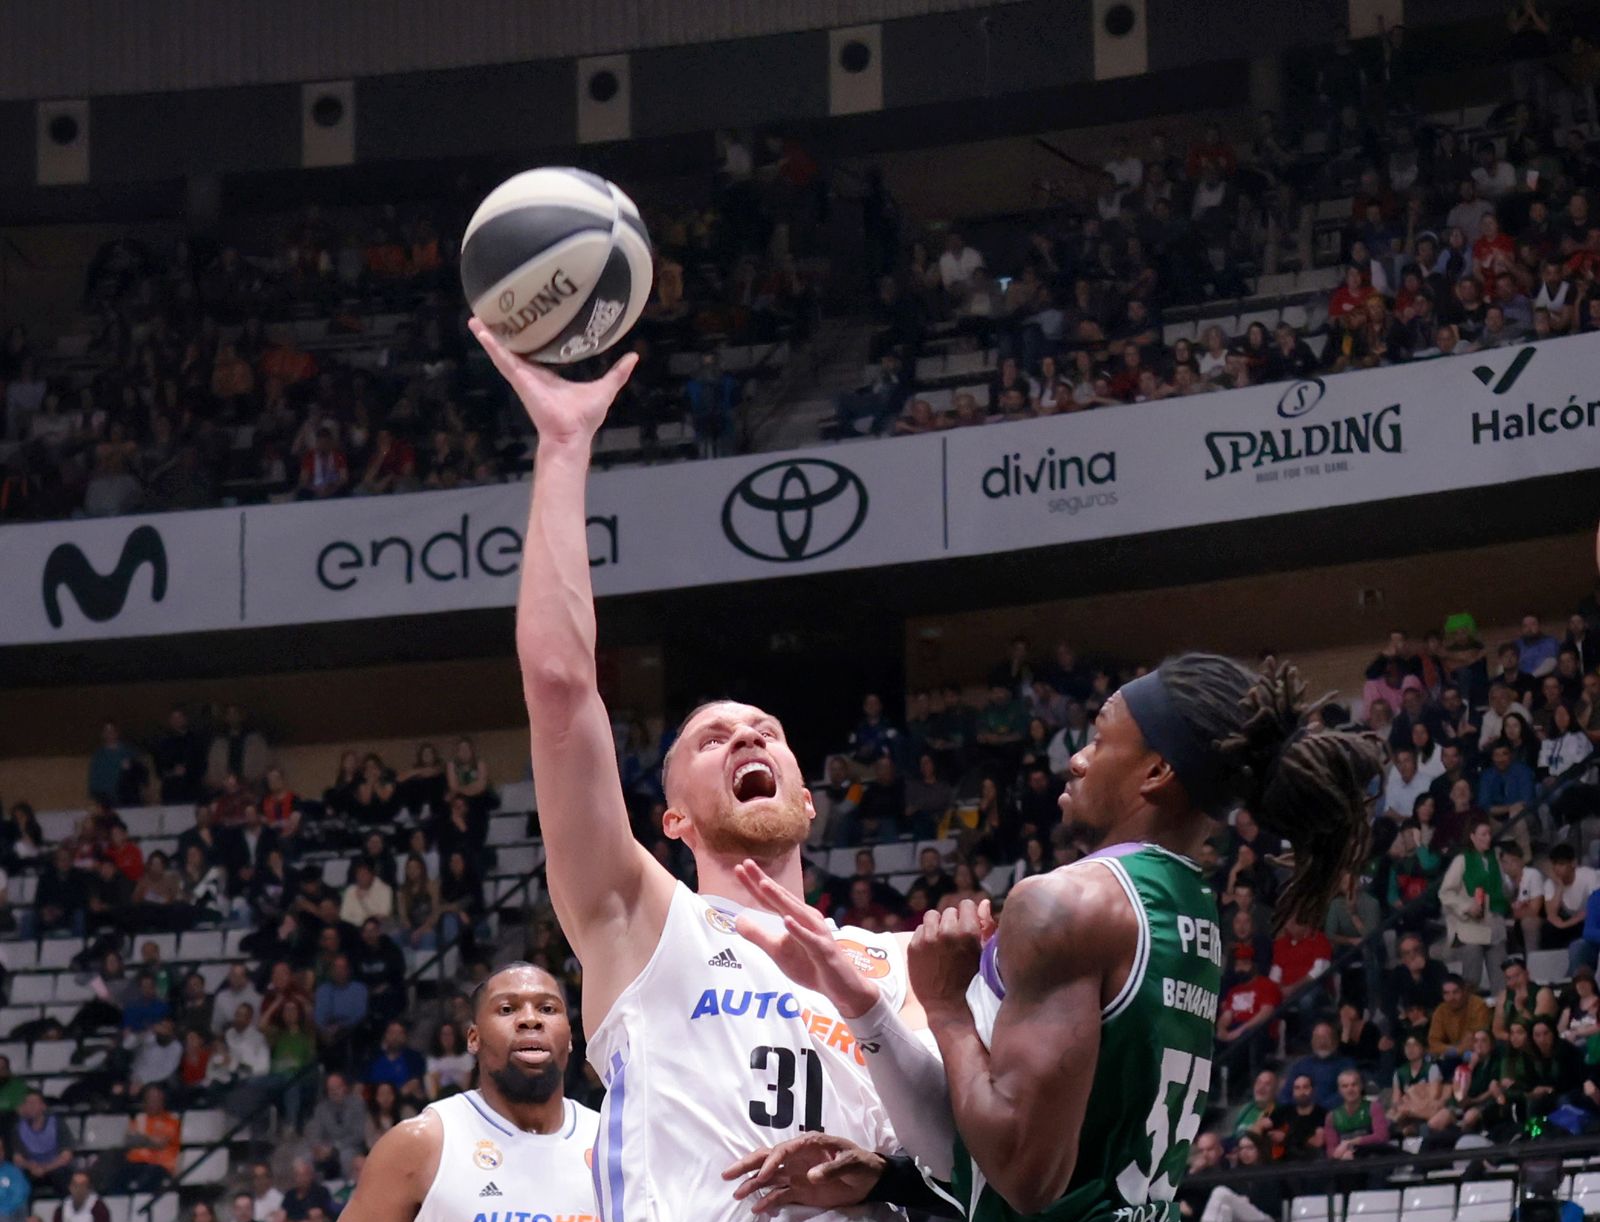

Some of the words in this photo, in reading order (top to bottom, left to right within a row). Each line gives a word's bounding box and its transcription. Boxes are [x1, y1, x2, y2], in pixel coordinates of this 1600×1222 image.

[982, 447, 1116, 499] divina
[1204, 403, 1402, 480] SPALDING
[1047, 490, 1119, 516] seguros
[317, 513, 619, 591] endea
[708, 956, 742, 970] adidas
[749, 1045, 824, 1134] 31
[1115, 1047, 1213, 1206] 55
